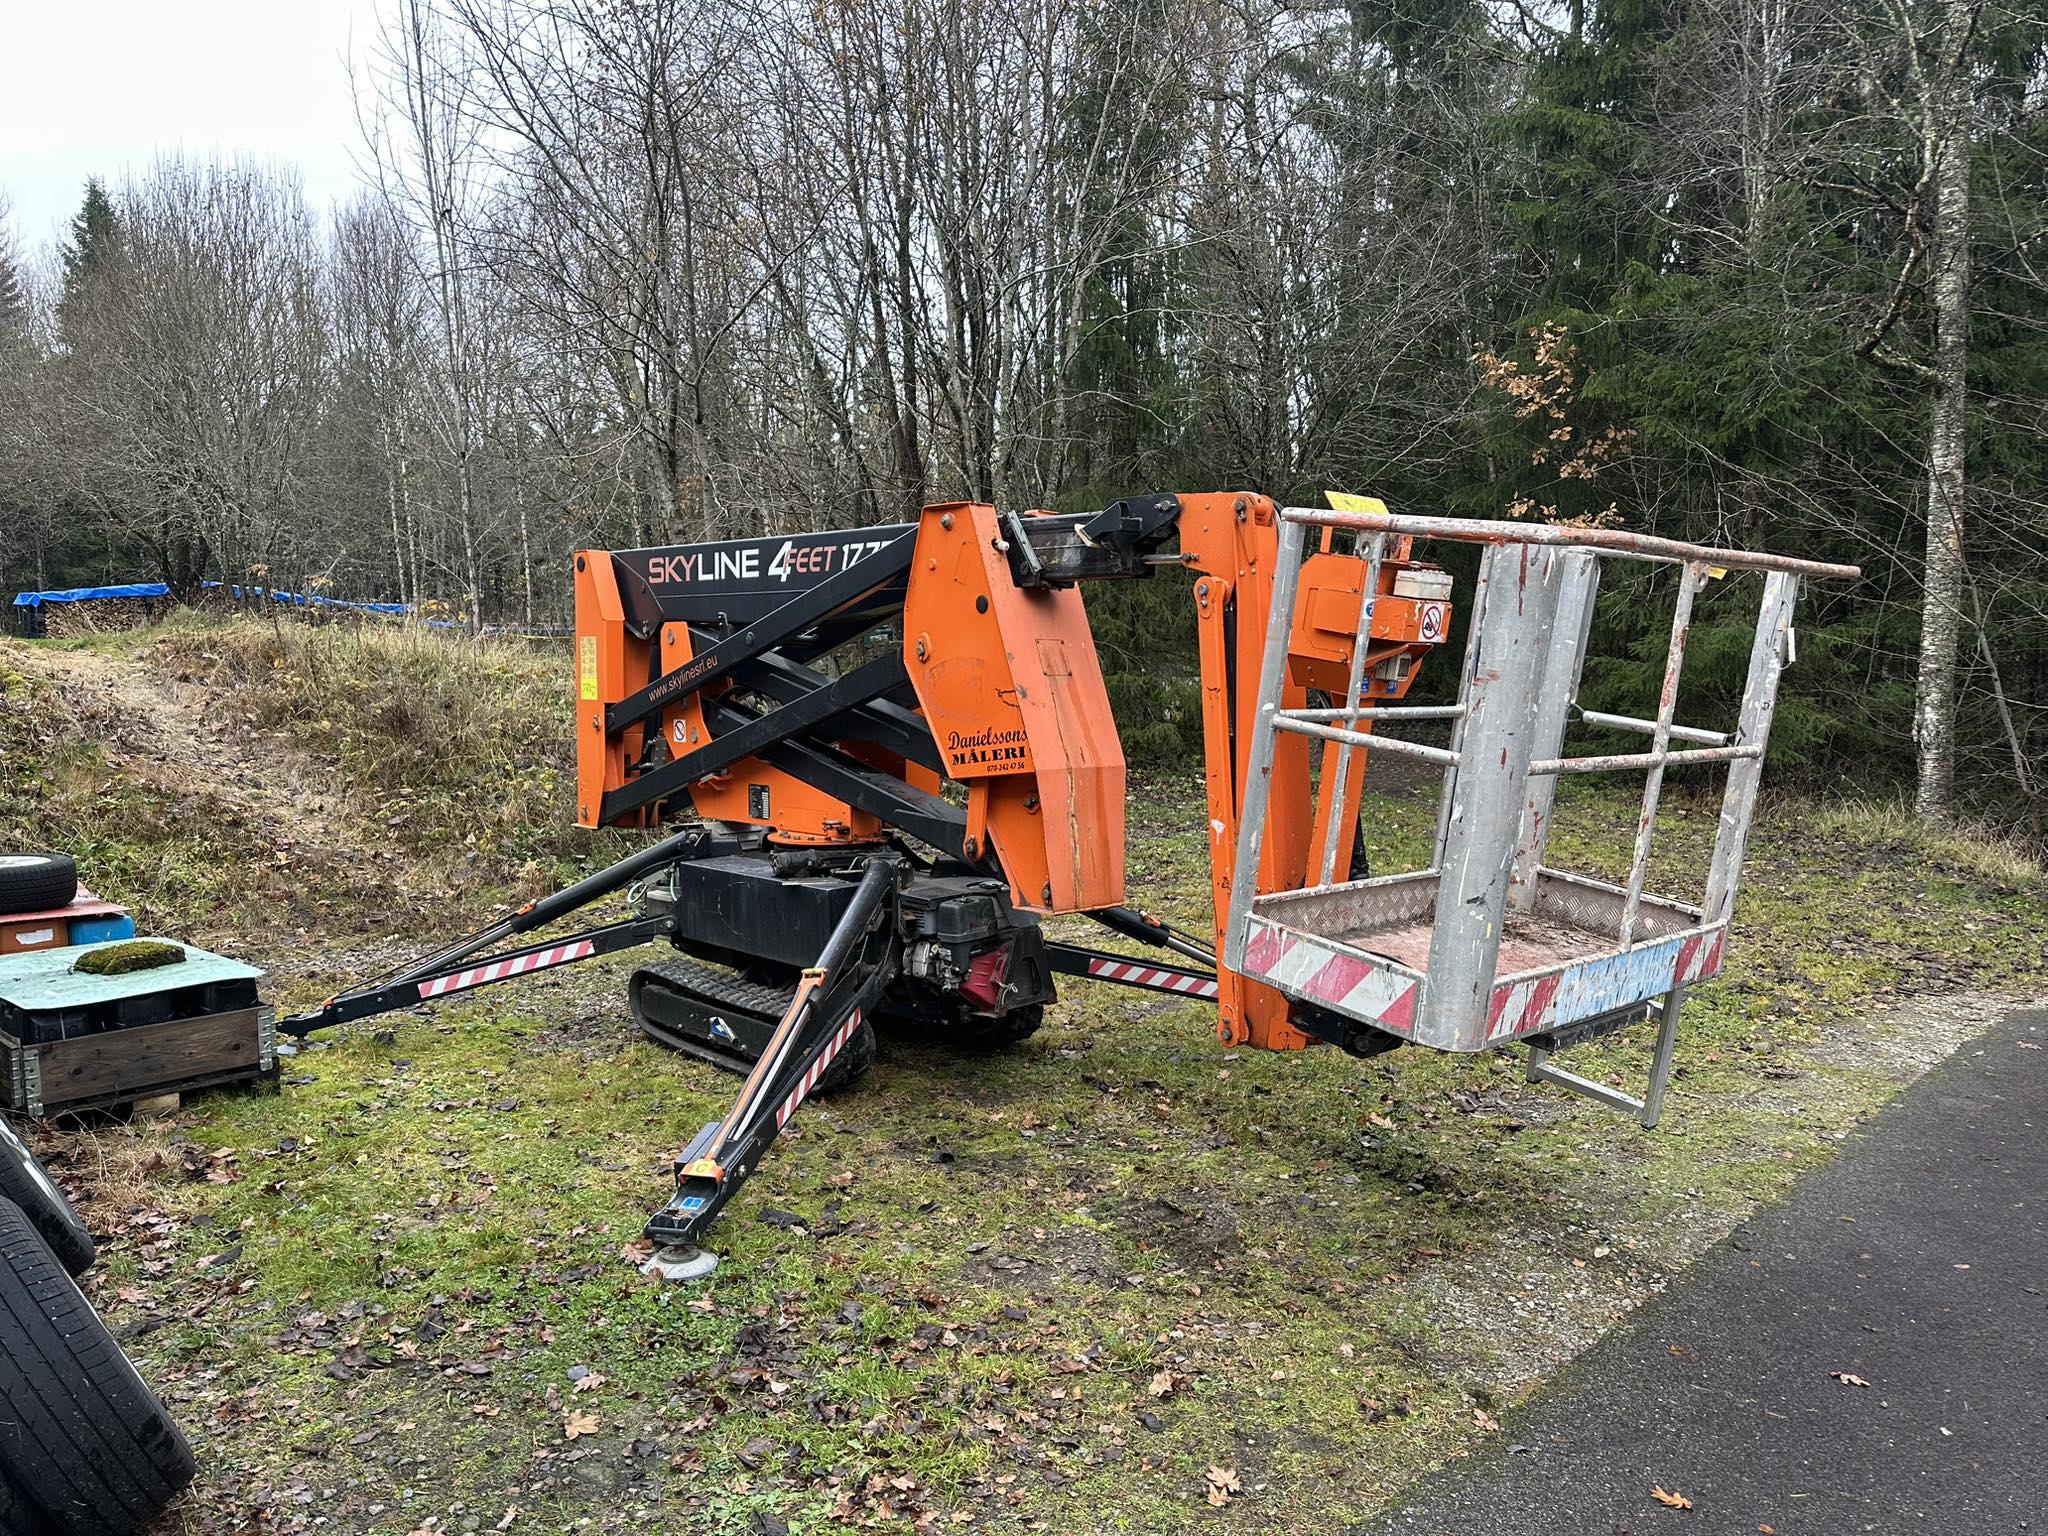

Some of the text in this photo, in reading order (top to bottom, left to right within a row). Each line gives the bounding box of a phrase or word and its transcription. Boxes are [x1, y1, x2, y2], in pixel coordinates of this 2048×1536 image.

[648, 548, 760, 584] SKYLINE
[648, 655, 719, 702] www.skylinesrl.eu
[948, 726, 1028, 750] Danielssons
[952, 746, 1026, 765] MÅLERI
[1010, 762, 1017, 770] 47
